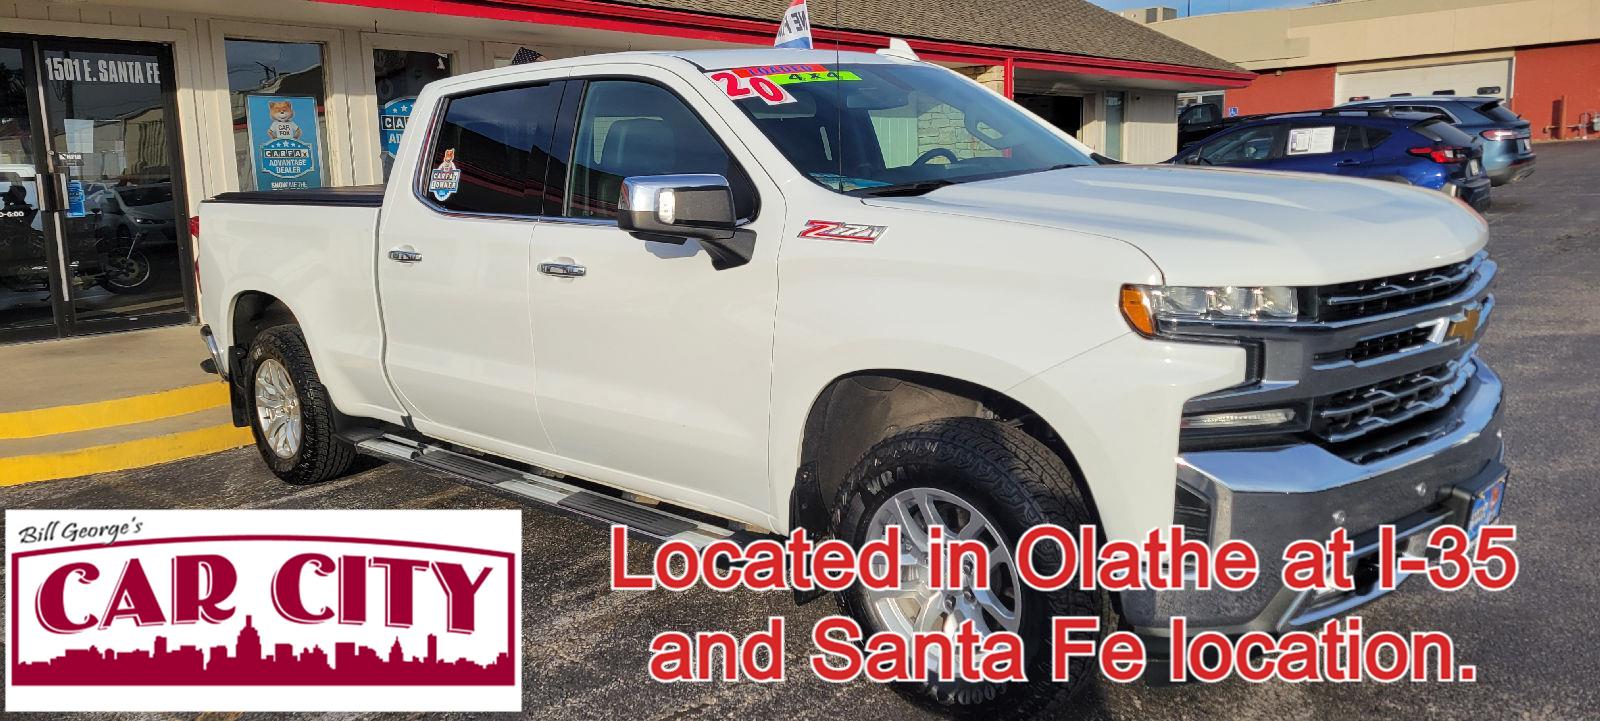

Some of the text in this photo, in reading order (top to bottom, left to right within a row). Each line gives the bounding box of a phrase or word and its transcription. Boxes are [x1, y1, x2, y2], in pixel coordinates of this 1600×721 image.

[45, 58, 160, 84] 1501 E. SANTA FE
[711, 72, 784, 102] 20
[269, 159, 307, 167] ADVANTAGE
[276, 166, 301, 174] DEALER
[797, 219, 888, 244] Z71
